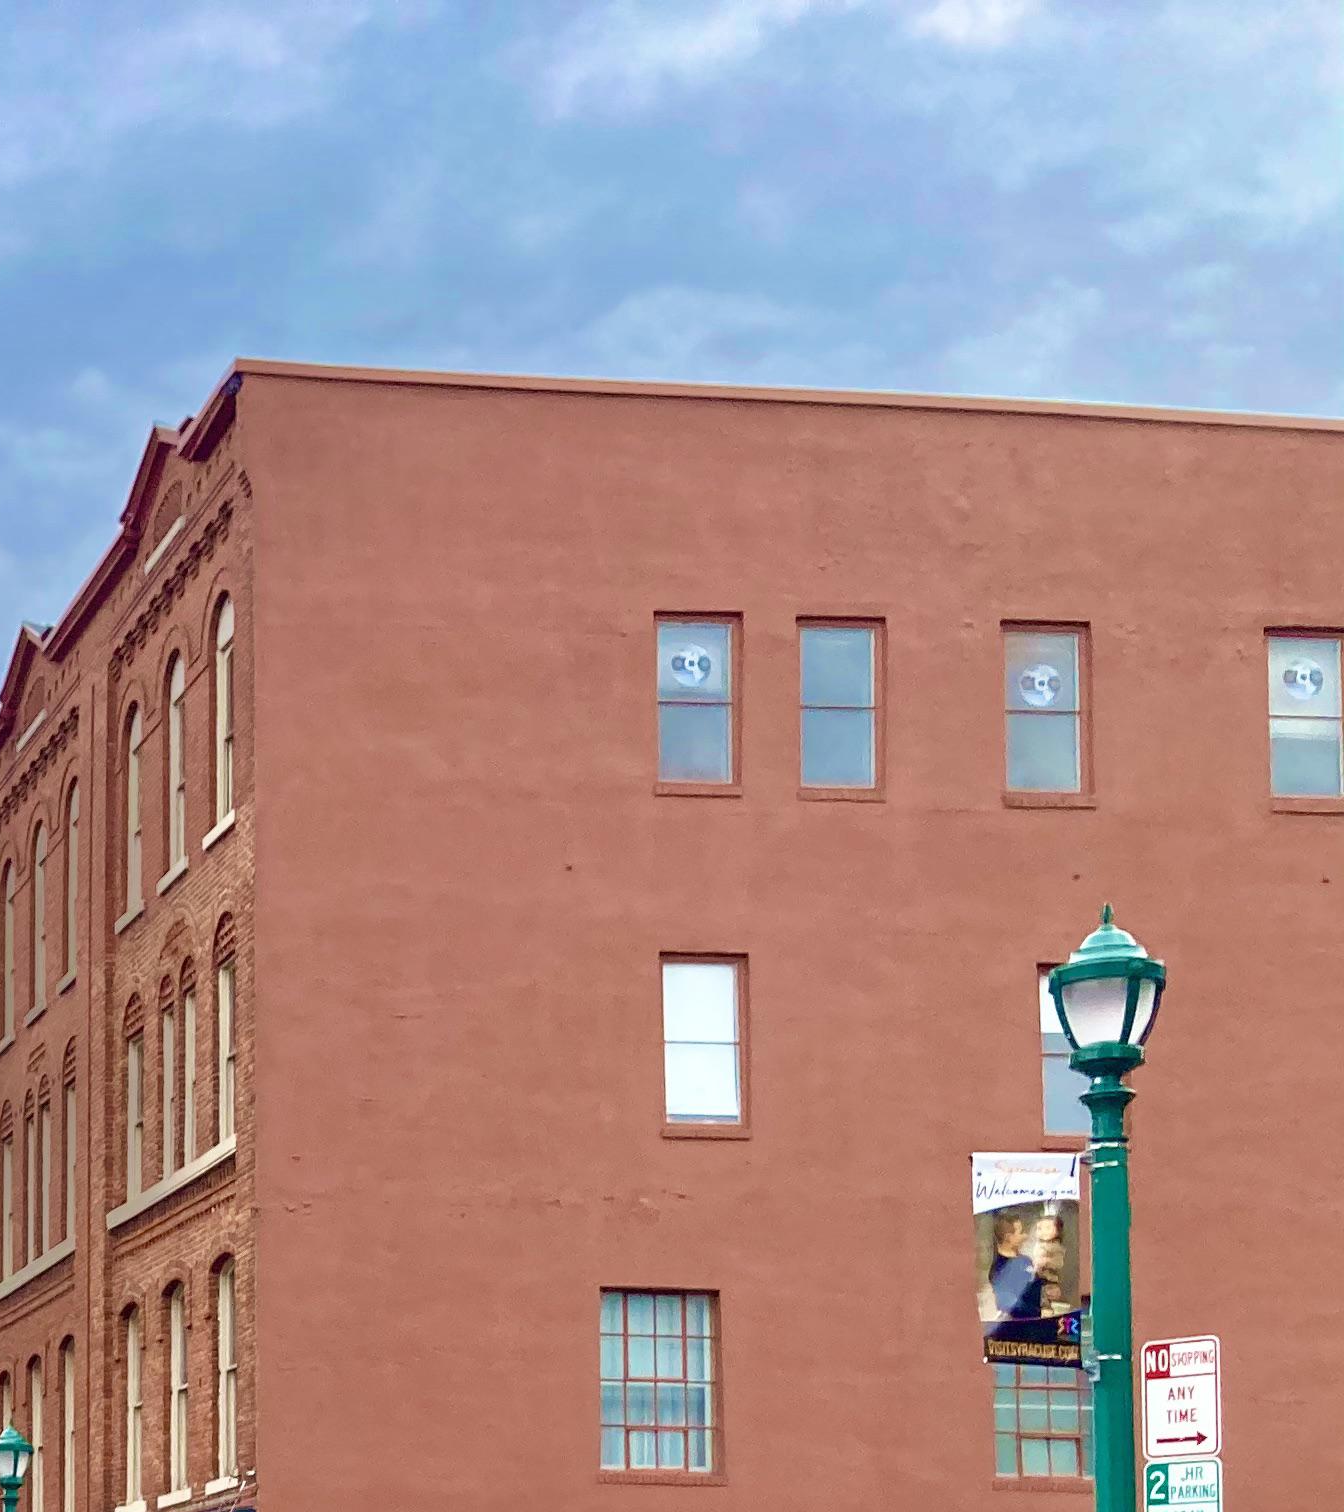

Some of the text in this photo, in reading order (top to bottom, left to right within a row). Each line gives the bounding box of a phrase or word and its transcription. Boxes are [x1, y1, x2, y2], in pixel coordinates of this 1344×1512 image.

[975, 1178, 1045, 1200] Welcomes
[1145, 1349, 1215, 1373] NO STOPPING
[1167, 1386, 1196, 1401] ANY
[1166, 1408, 1198, 1424] TIME
[1149, 1466, 1204, 1500] 2 HR
[1170, 1484, 1217, 1500] PARKING
